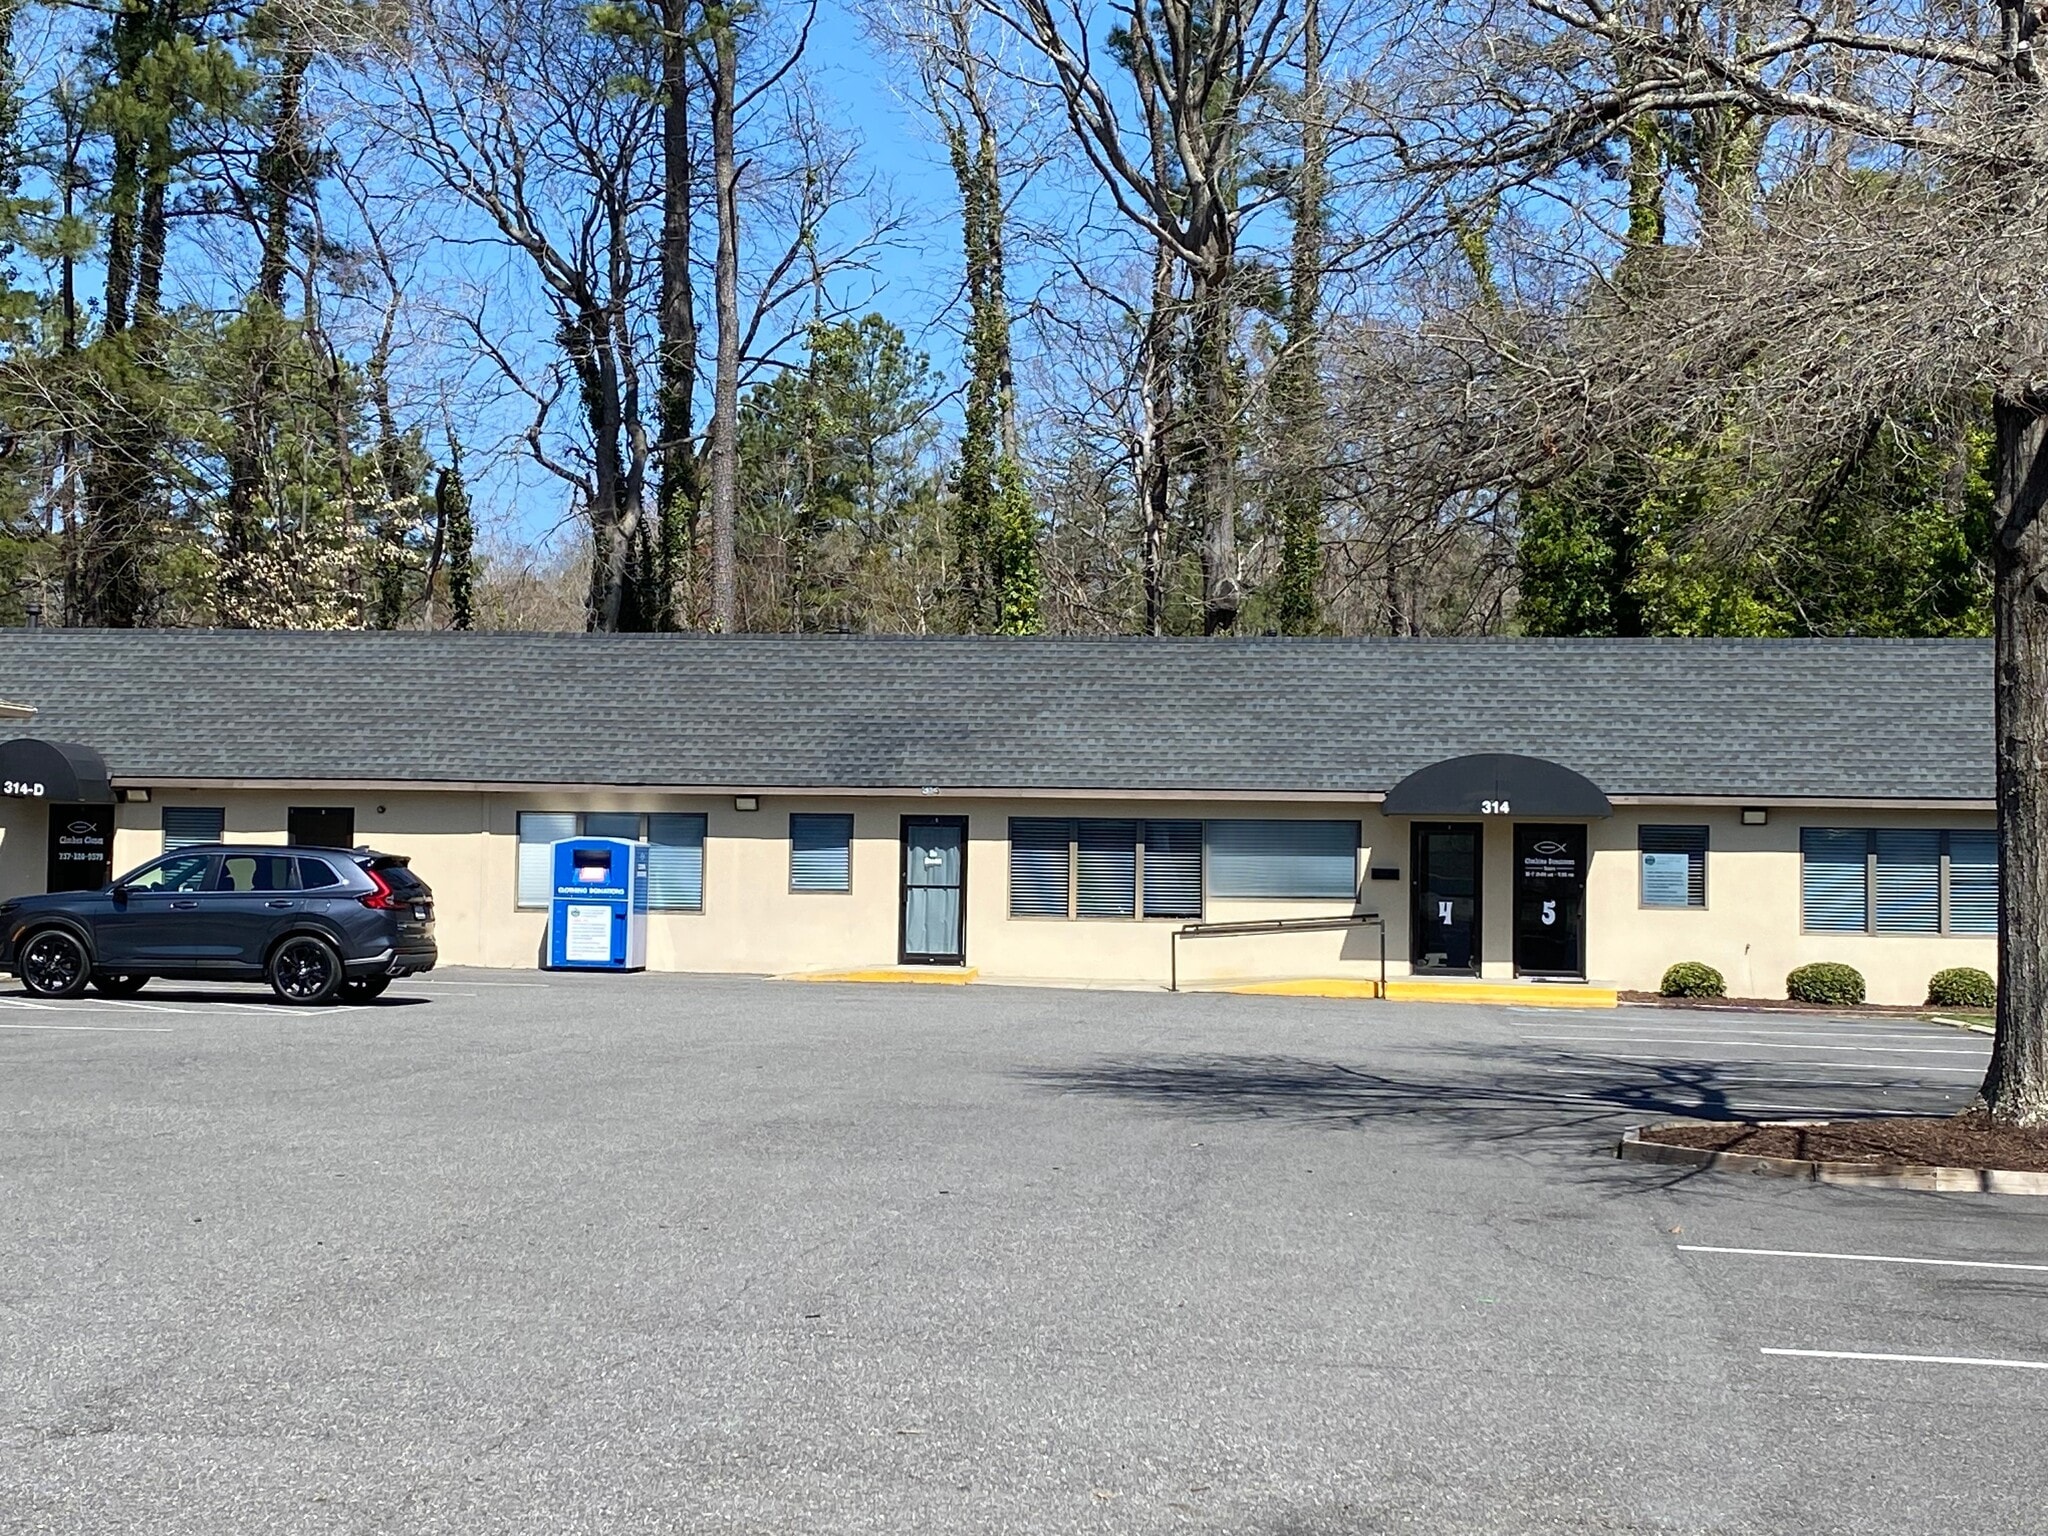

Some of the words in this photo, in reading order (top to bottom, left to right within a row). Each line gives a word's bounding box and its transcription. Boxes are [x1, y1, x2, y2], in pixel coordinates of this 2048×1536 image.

[3, 781, 44, 796] 314-D
[1481, 800, 1510, 814] 314
[1438, 901, 1453, 925] 4
[1541, 900, 1556, 925] 5
